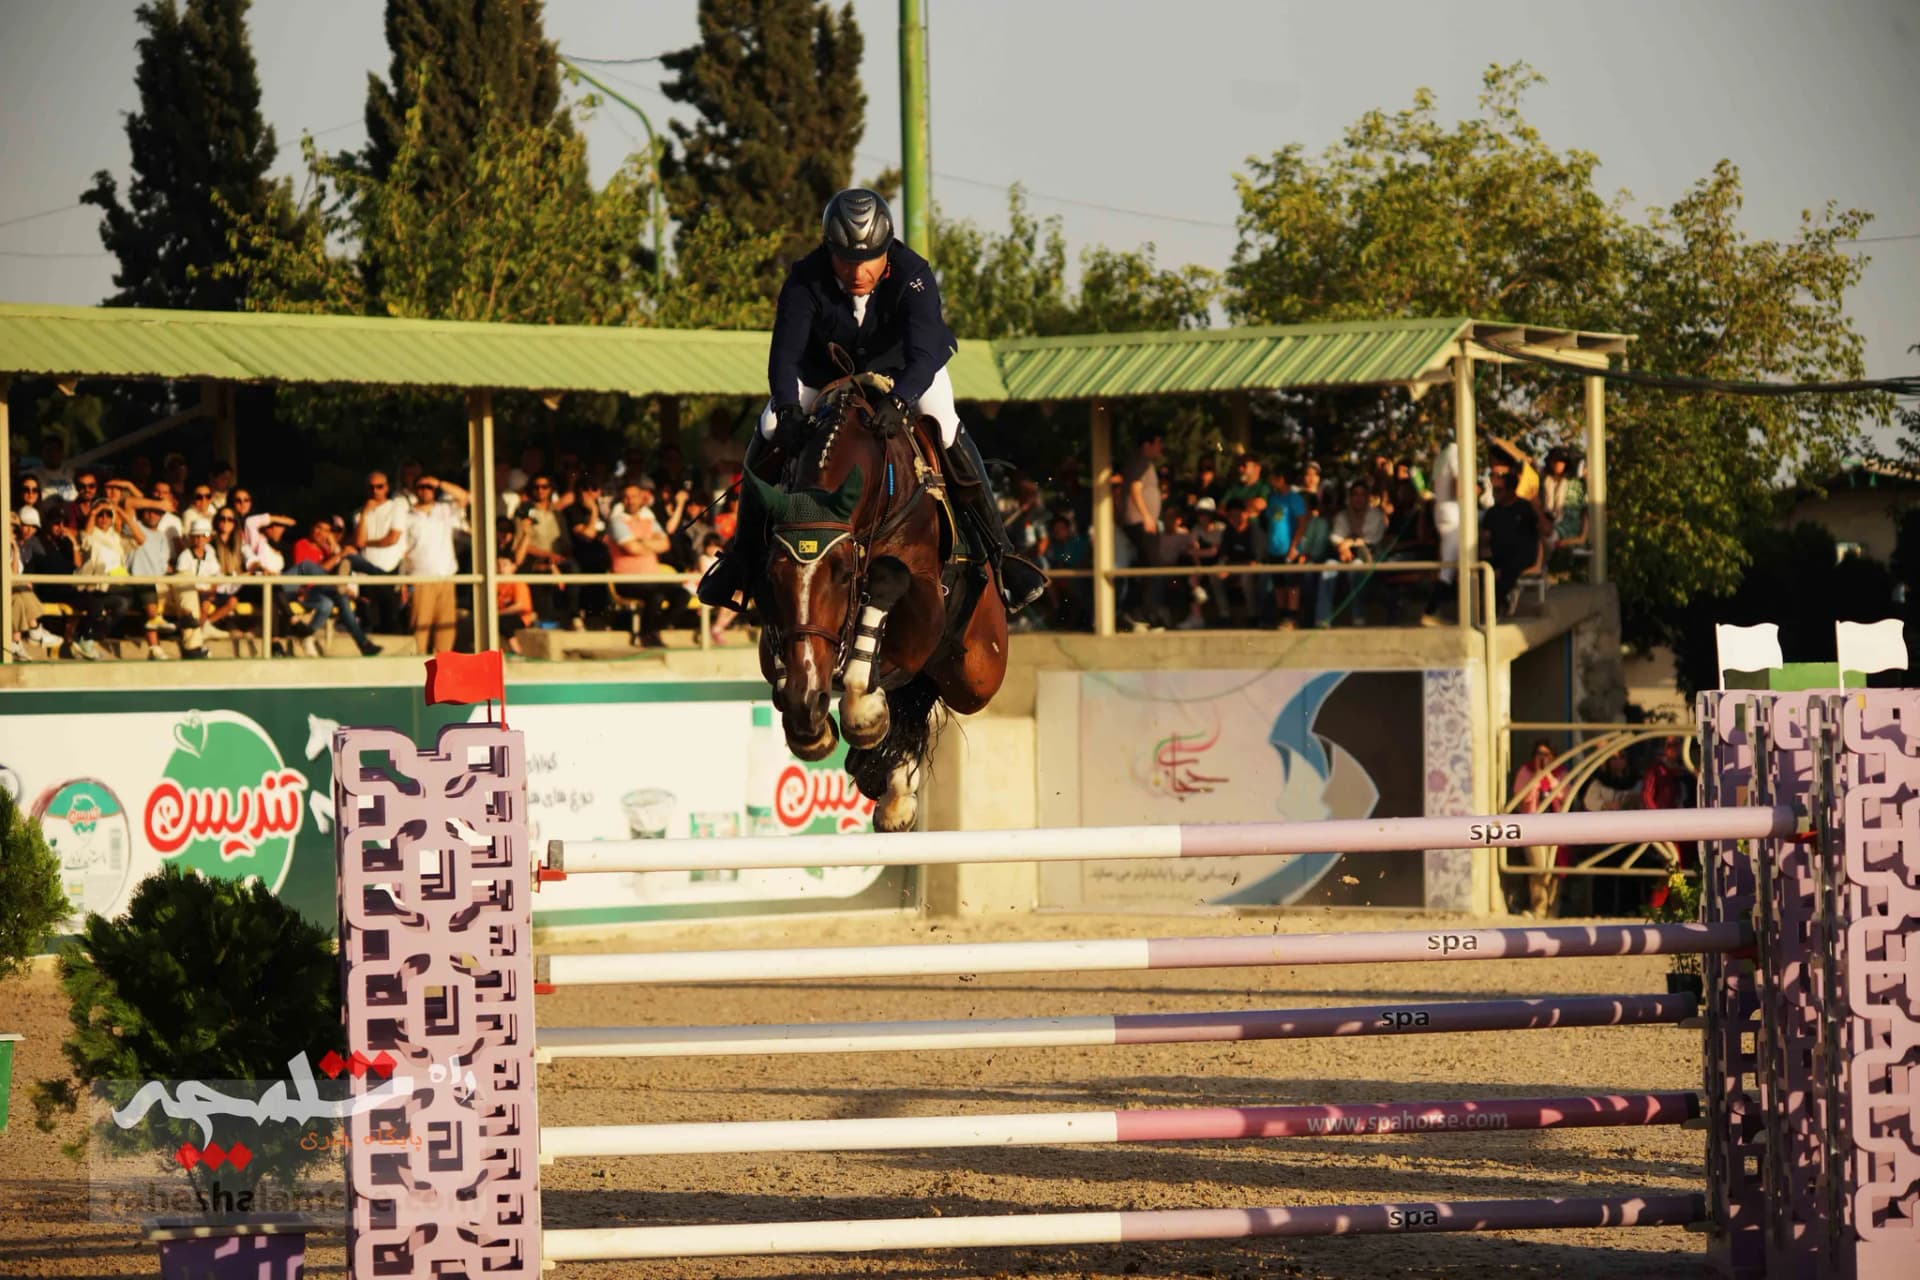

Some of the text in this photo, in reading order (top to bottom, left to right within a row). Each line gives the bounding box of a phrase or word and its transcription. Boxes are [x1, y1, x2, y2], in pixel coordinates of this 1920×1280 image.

[1470, 823, 1521, 845] spa
[1427, 934, 1478, 955] spa
[1382, 1011, 1430, 1029] spa
[1307, 1110, 1508, 1133] www.spahorse.com
[1390, 1209, 1438, 1230] spa
